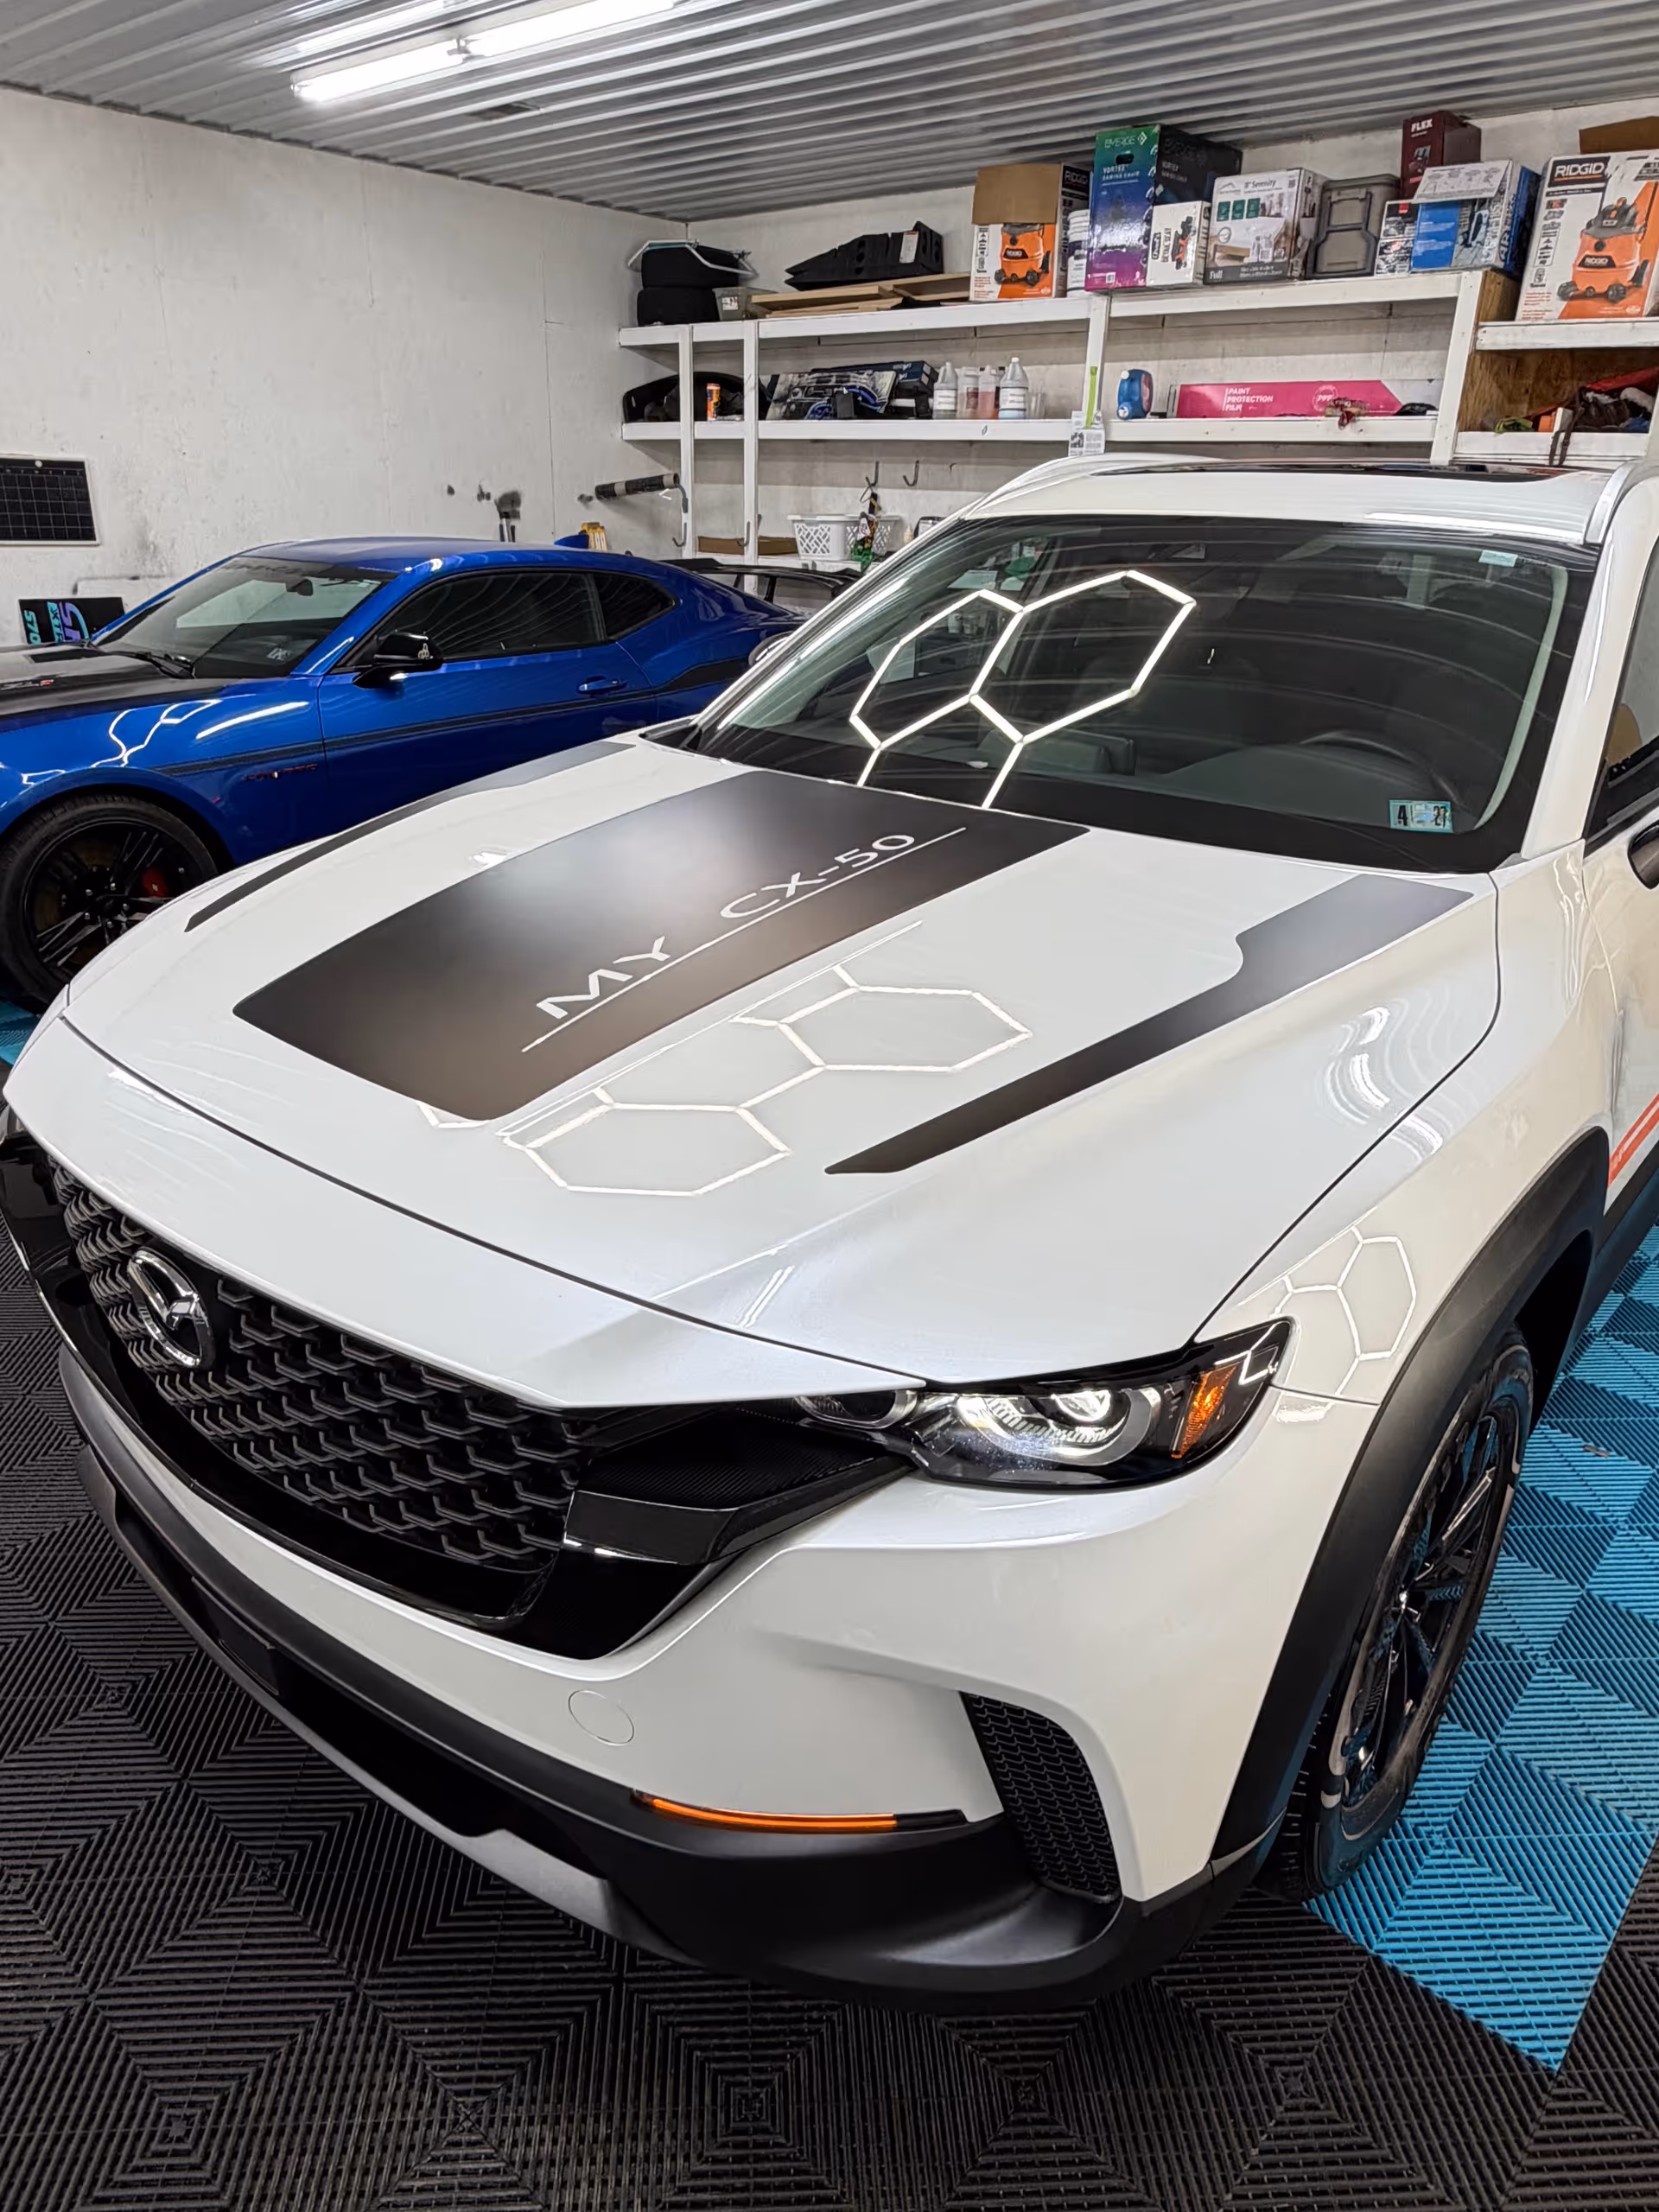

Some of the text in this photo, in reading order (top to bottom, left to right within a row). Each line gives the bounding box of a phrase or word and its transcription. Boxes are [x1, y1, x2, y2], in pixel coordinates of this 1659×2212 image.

[1410, 118, 1433, 132] FLEX
[1554, 162, 1605, 177] RIDGID
[1252, 180, 1276, 188] Serenity
[1226, 395, 1274, 404] PROTECTION
[1225, 404, 1243, 412] FILM
[536, 833, 914, 1019] MY CX-50
